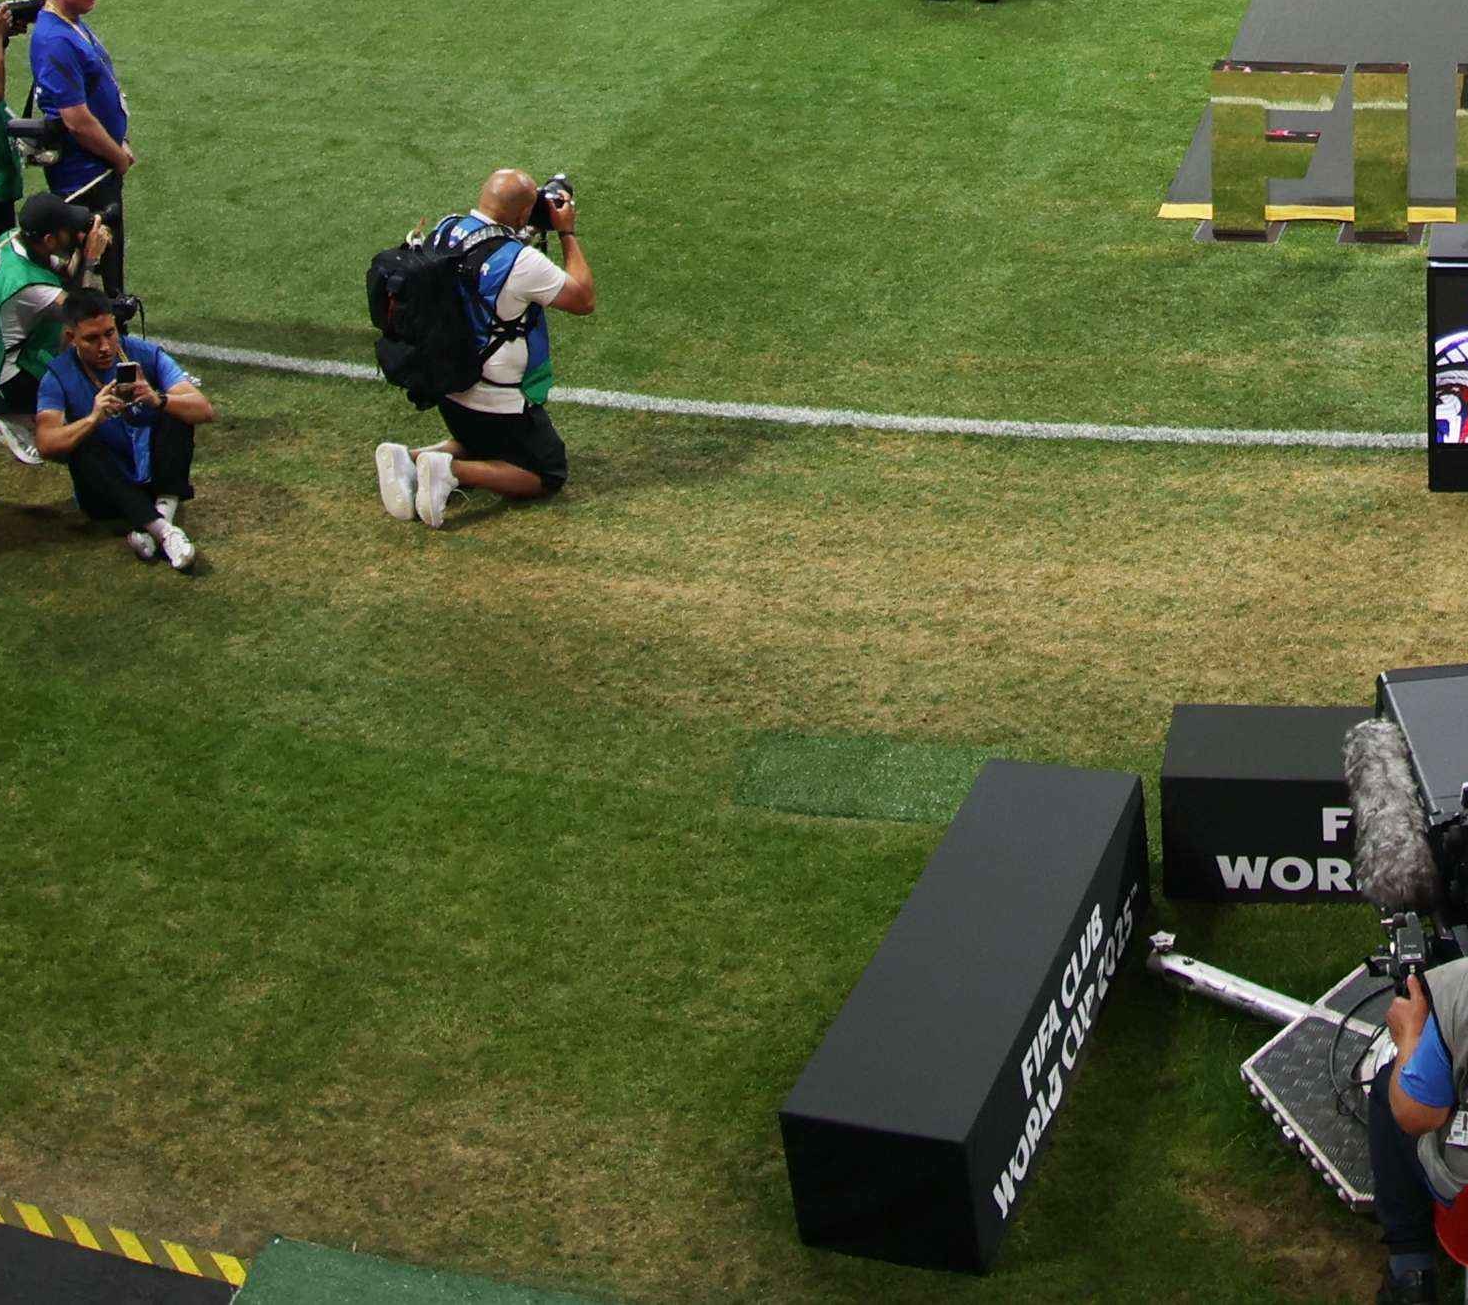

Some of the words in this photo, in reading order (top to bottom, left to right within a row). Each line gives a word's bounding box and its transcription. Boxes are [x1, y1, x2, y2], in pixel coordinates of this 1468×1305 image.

[1216, 855, 1360, 892] WOR
[1021, 999, 1063, 1099] FIFA
[1061, 903, 1104, 1009] CLUB
[992, 1062, 1064, 1220] WORLD
[1061, 983, 1096, 1071] CUP
